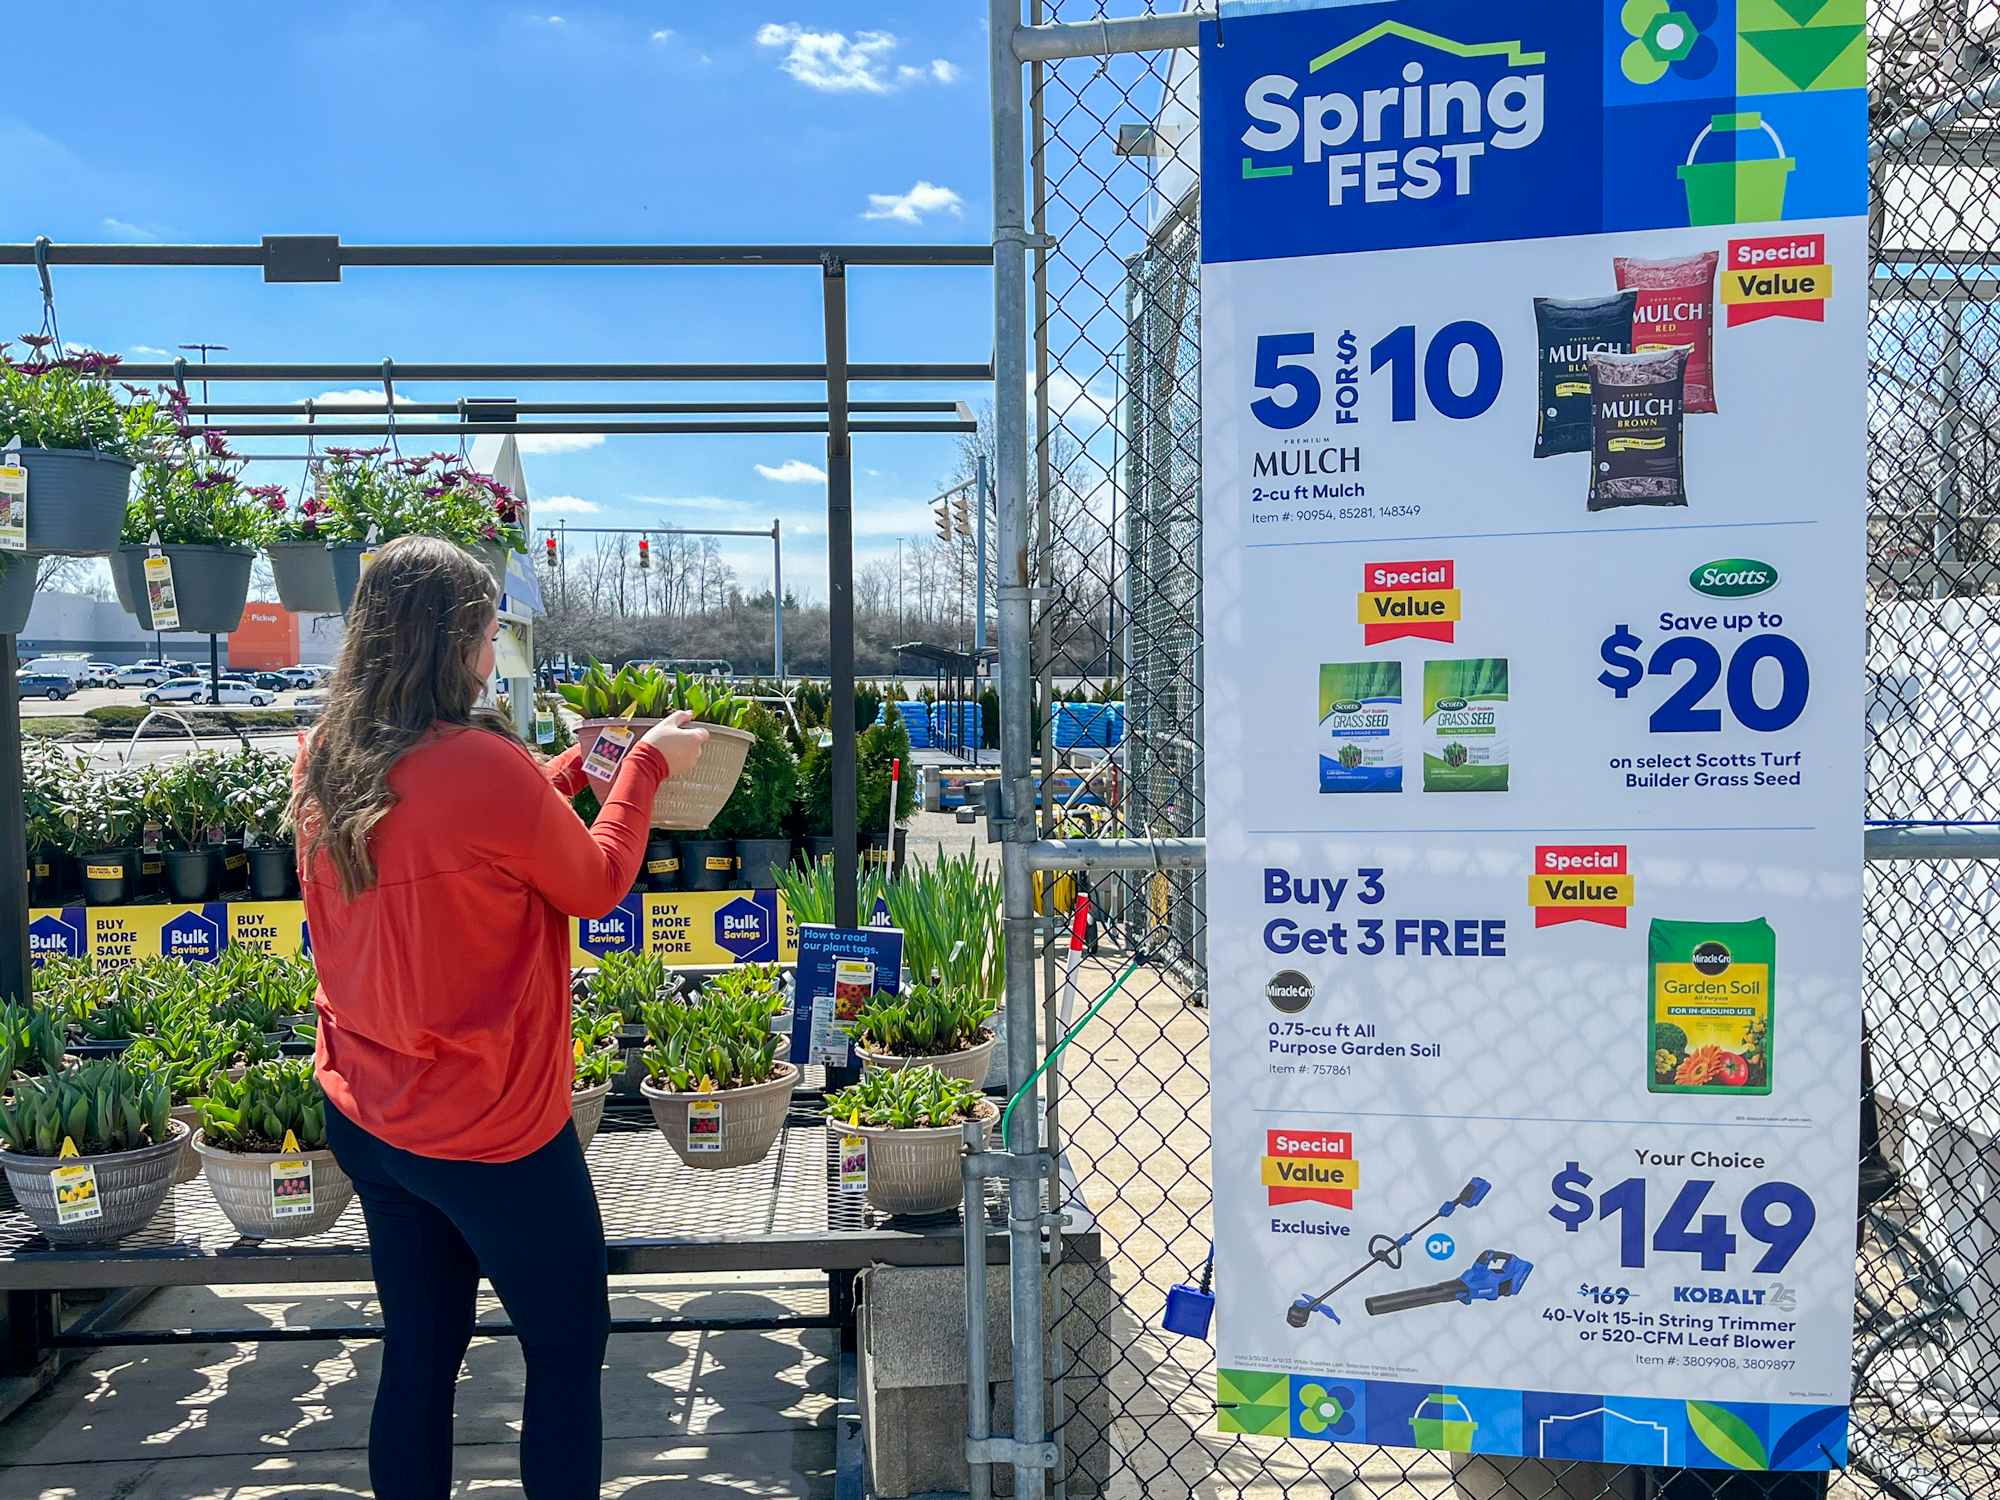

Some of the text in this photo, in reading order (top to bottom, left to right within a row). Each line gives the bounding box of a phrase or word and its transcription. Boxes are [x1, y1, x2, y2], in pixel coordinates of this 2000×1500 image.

[1241, 61, 1545, 163] Spring
[1329, 142, 1485, 206] FEST
[1737, 241, 1816, 265] Special
[1737, 273, 1815, 296] Value
[1632, 302, 1703, 324] MULCH
[1655, 324, 1676, 333] RED
[1568, 364, 1588, 373] BLA
[1250, 332, 1321, 430] 5
[1601, 399, 1673, 419] MULCH
[1617, 418, 1658, 428] BROWN
[1283, 437, 1330, 445] PREMIUM
[1253, 447, 1360, 478] MULCH
[1252, 483, 1365, 502] 2-cu ft Mulch
[1252, 513, 1279, 524] Item
[1339, 507, 1376, 519] 85281,
[1379, 505, 1421, 517] 148349
[1374, 567, 1446, 588] Special
[1700, 568, 1767, 587] Scotts
[1374, 596, 1446, 617] Value
[1659, 611, 1783, 632] Save up to
[1597, 624, 1810, 733] $20
[1334, 714, 1389, 728] GRASS SEED
[1438, 712, 1495, 726] GRASS SEED
[1609, 751, 1801, 769] on select Scotts Turf
[1626, 771, 1801, 788] Builder Grass Seed
[1544, 851, 1618, 871] Special
[1264, 868, 1385, 912] Buy 3
[1544, 880, 1618, 900] Value
[652, 905, 679, 915] BUY
[96, 919, 125, 930] BUY
[237, 915, 265, 925] BUY
[588, 918, 625, 934] Bulk
[652, 917, 691, 927] MORE
[724, 914, 760, 930] Bulk
[29, 934, 68, 949] Bulk
[96, 932, 137, 943] MORE
[171, 929, 209, 945] Bulk
[237, 928, 278, 938] MORE
[588, 935, 626, 944] Savings
[652, 930, 686, 940] SAVE
[724, 930, 761, 940] Savings
[804, 929, 867, 942] How to read
[1264, 918, 1506, 957] Get 3 FREE
[96, 945, 132, 956] SAVE
[171, 945, 209, 956] Savings
[652, 943, 692, 953] MORE
[803, 942, 879, 956] our plant tags.
[1664, 980, 1760, 994] Garden Soil
[1688, 1007, 1735, 1015] IN-GROUND
[1269, 1022, 1376, 1037] 0.75-cu ft All
[1269, 1040, 1441, 1057] Purpose Garden Soil
[1269, 1063, 1295, 1073] Item
[1313, 1065, 1351, 1076] 757861
[1276, 1136, 1344, 1154] Special
[1634, 1149, 1765, 1168] Your Choice
[1277, 1162, 1345, 1183] Value
[1548, 1161, 1816, 1274] $149
[1271, 1218, 1351, 1236] Exclusive
[1427, 1240, 1451, 1253] or
[1579, 1283, 1630, 1305] $169
[1673, 1286, 1766, 1306] KOBALT
[1542, 1308, 1796, 1332] 40-Volt 15-in String Trimmer
[1579, 1329, 1796, 1350] or 520-CFM Leaf Blower
[1636, 1355, 1664, 1366] Item
[1683, 1357, 1739, 1370] 3809908,
[1743, 1358, 1796, 1370] 3809897
